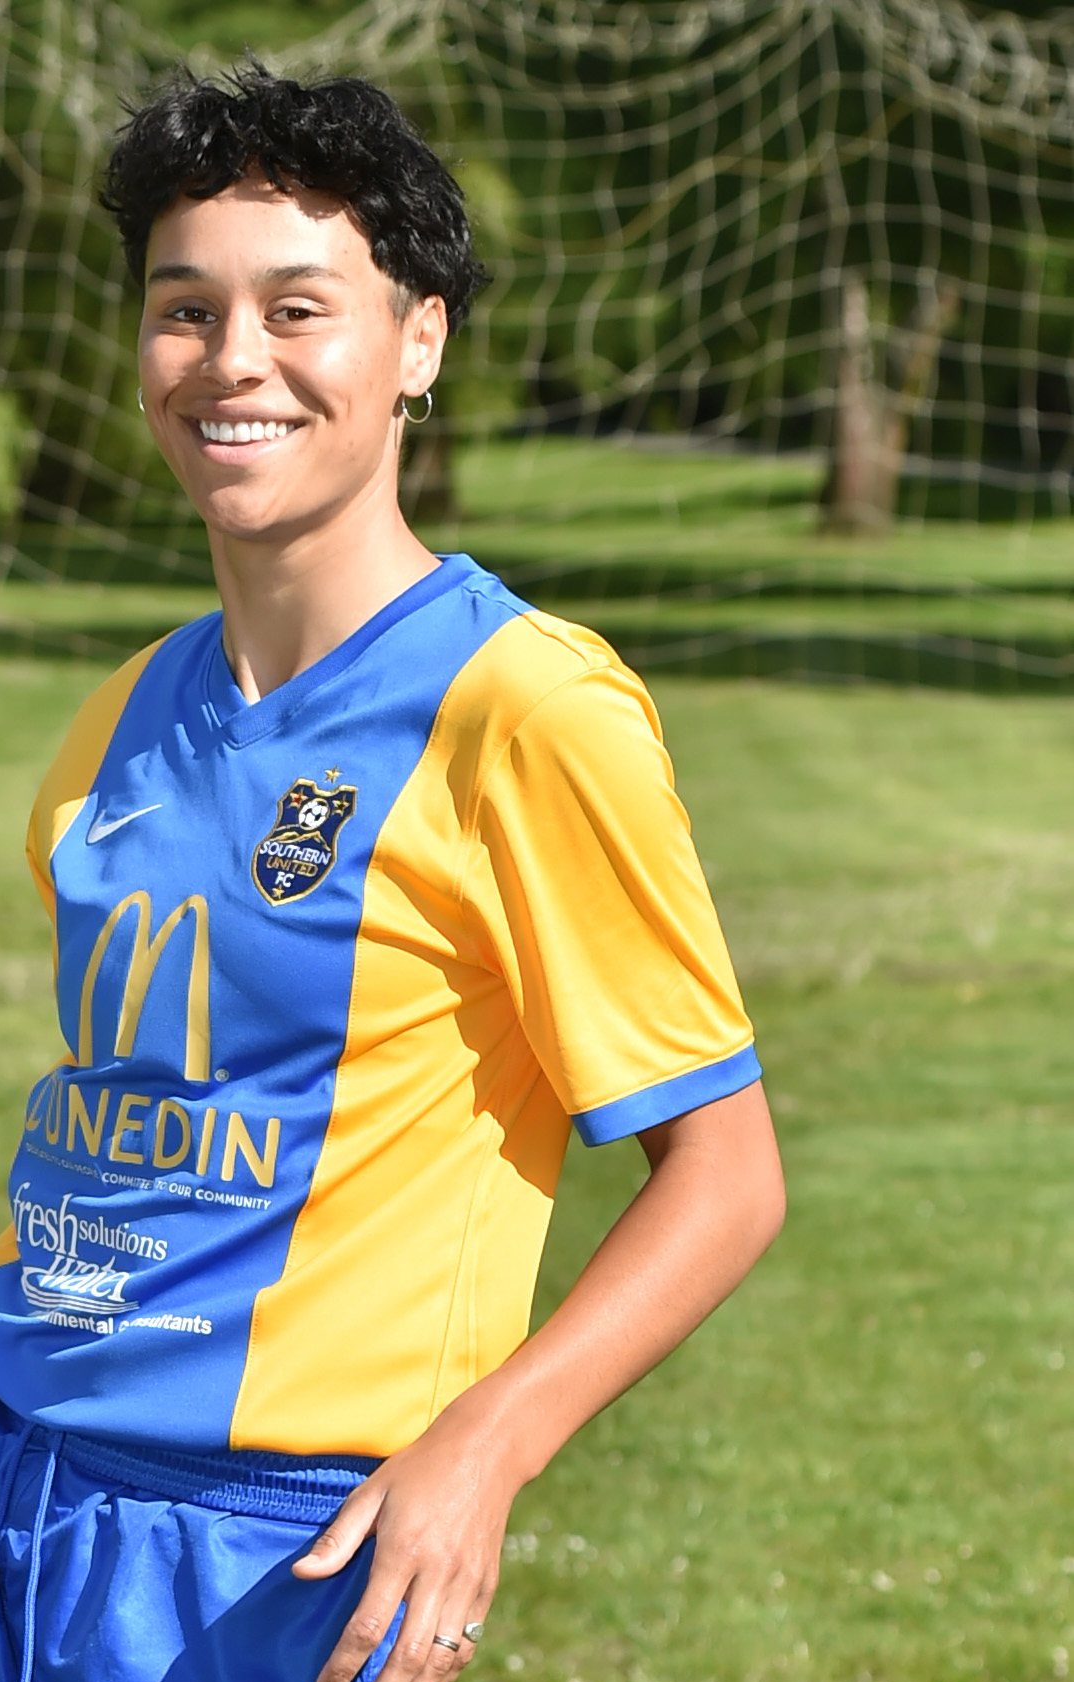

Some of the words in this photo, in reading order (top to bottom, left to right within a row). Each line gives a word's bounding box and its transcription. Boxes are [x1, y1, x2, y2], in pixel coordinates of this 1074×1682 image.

[259, 840, 332, 866] SOUTHERN
[266, 856, 319, 878] UNITED
[274, 871, 295, 888] FC
[101, 1171, 154, 1193] COMMITTE
[168, 1181, 193, 1199] OUR
[194, 1187, 273, 1211] COMMUNITY
[13, 1181, 78, 1259] fresh
[79, 1215, 169, 1262] solutions
